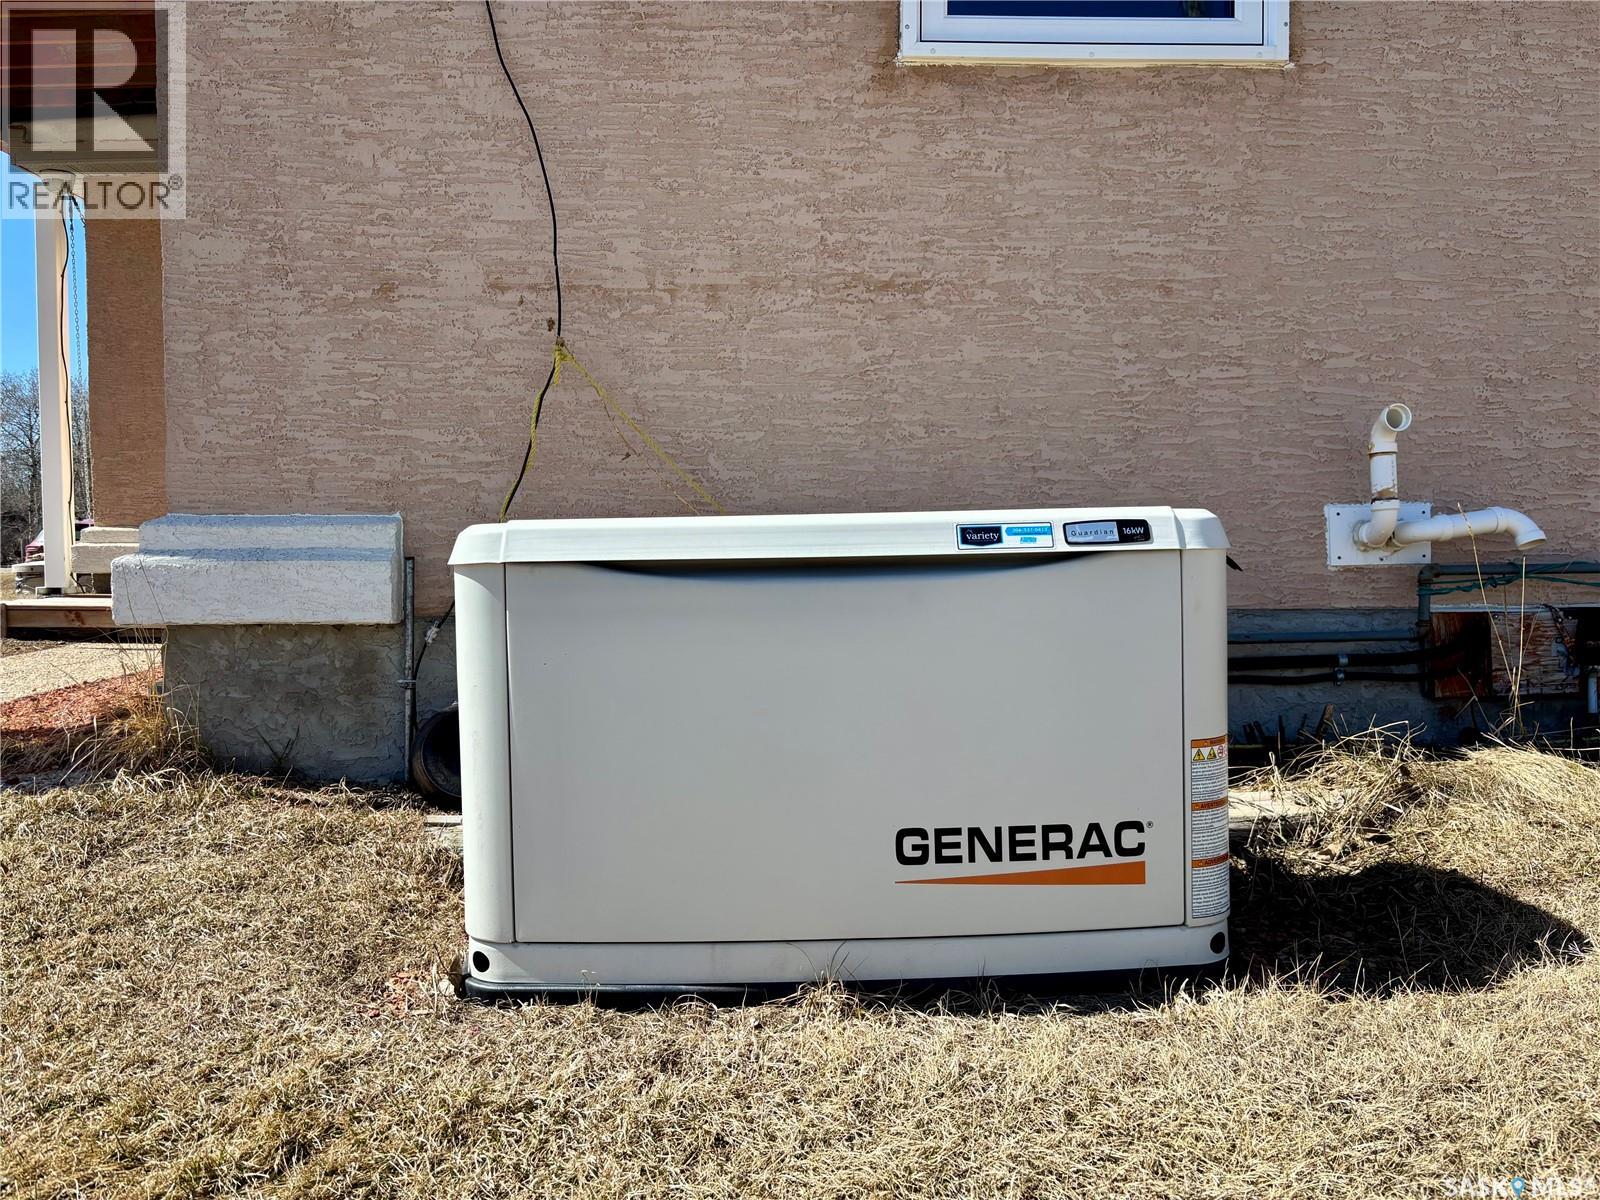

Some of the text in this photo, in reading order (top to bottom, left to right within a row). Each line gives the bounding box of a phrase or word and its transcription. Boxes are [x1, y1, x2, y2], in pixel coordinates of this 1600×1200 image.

[966, 531, 1000, 541] variety
[1070, 526, 1145, 537] Guardian 16kW
